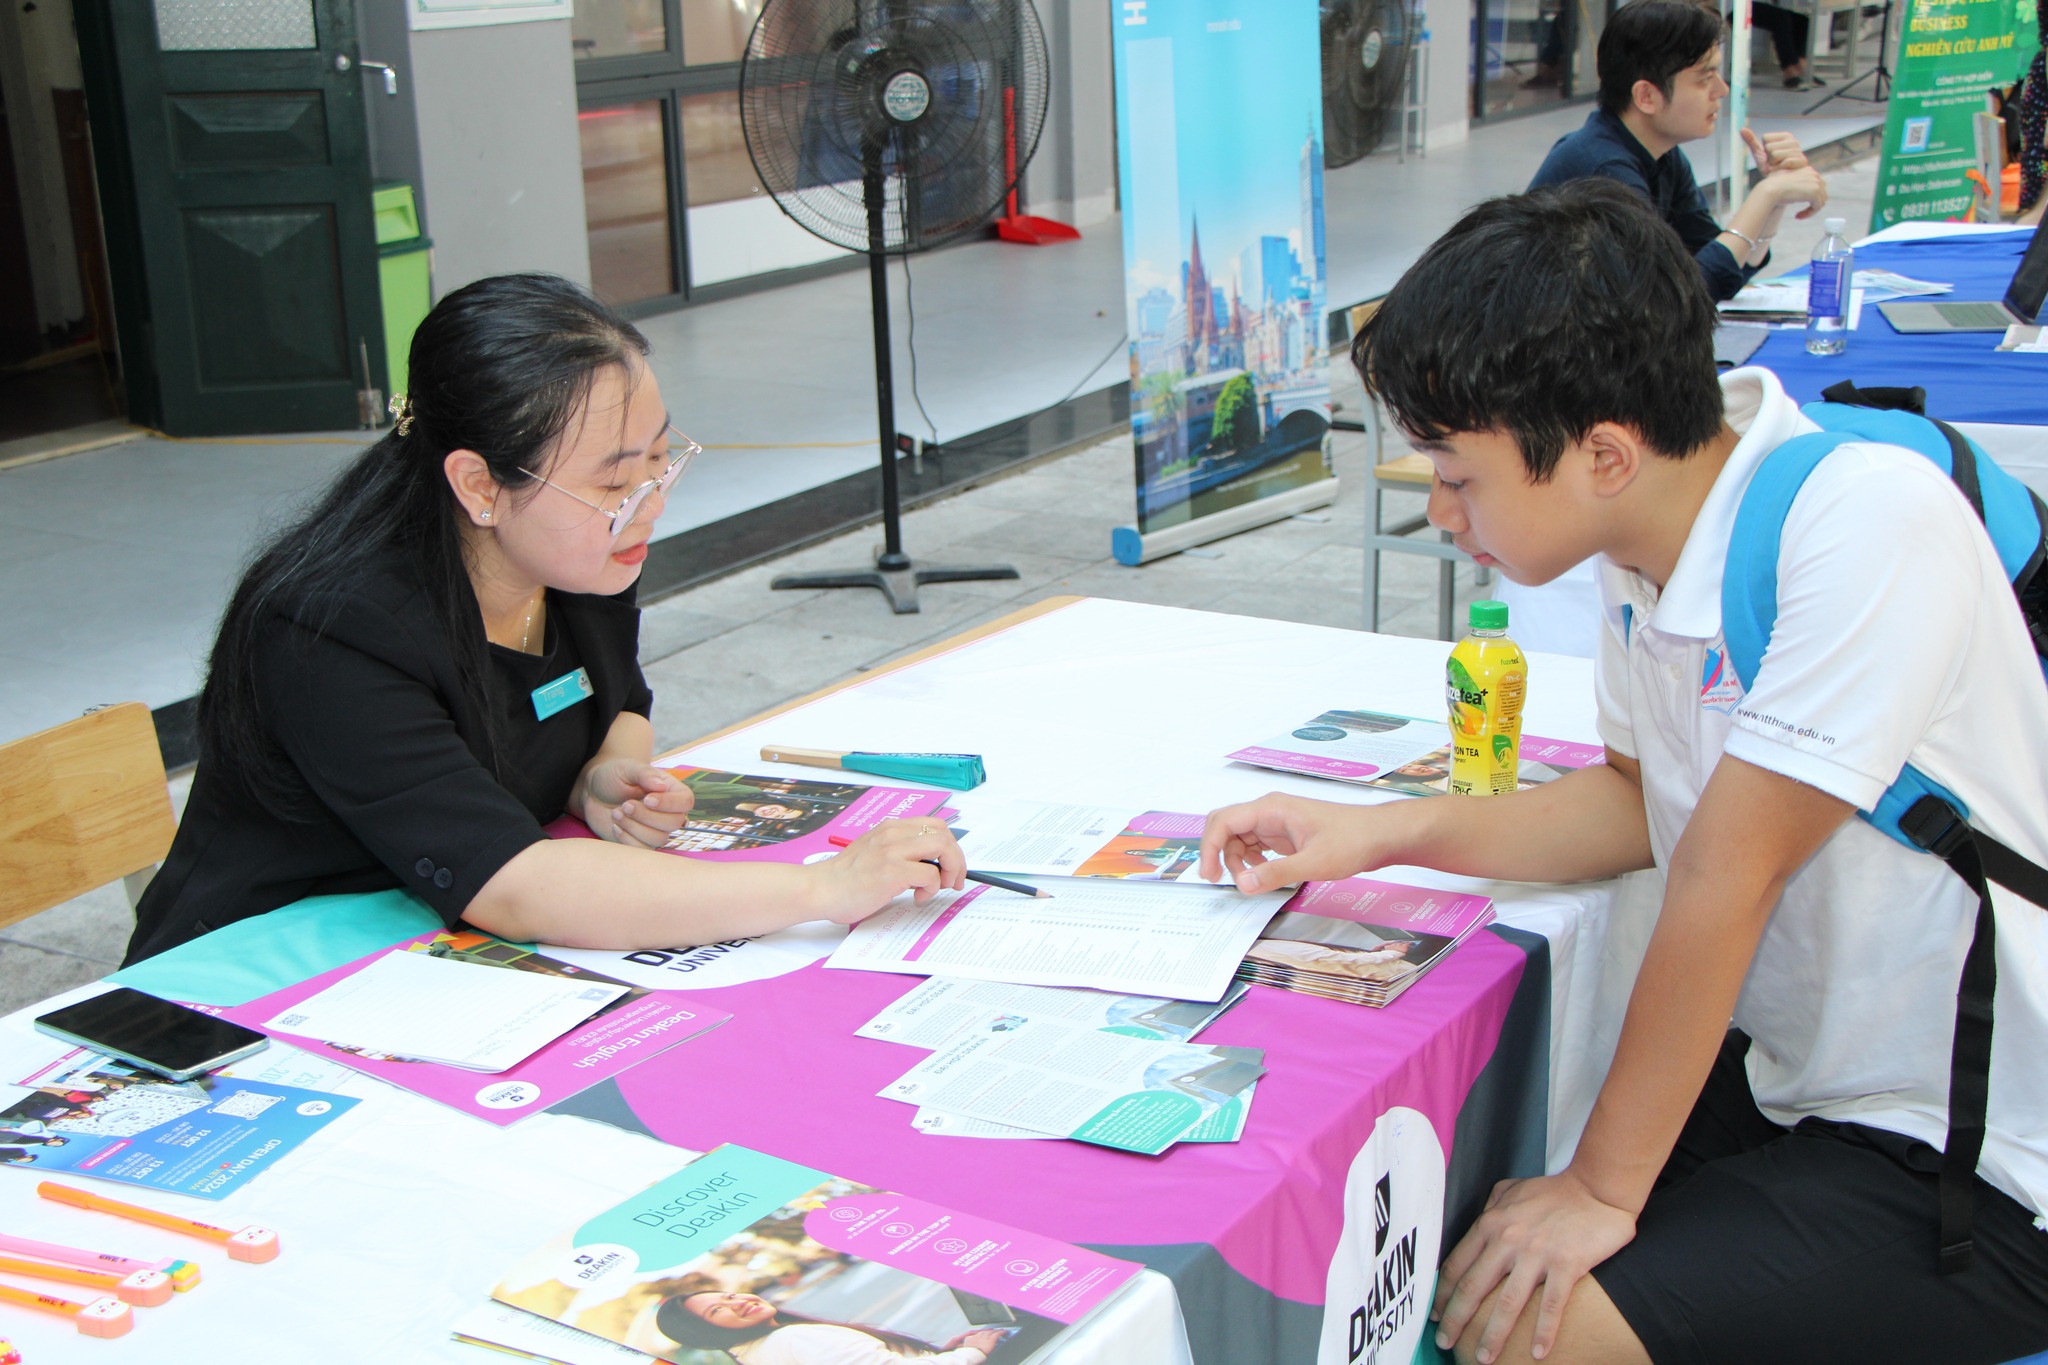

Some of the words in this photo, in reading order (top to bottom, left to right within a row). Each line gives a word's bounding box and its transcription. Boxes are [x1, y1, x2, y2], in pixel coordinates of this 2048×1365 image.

[1910, 15, 1968, 32] BUSINESS
[1977, 36, 1999, 52] ANH
[1901, 201, 1930, 219] 0931
[541, 685, 564, 703] Trang
[1465, 747, 1479, 758] TEA
[888, 793, 925, 816] Deakin
[930, 983, 954, 998] DEAKIN
[634, 1010, 696, 1039] Deakin
[567, 1031, 599, 1046] (DUELI)
[961, 1038, 989, 1055] DEAKIN
[573, 1037, 642, 1068] English
[490, 1086, 524, 1102] DEAKIN
[180, 1136, 201, 1148] OCT
[196, 1129, 211, 1137] 12
[248, 1139, 282, 1160] OPEN
[132, 1167, 153, 1179] OCT
[148, 1160, 164, 1168] 13
[228, 1159, 255, 1175] DAY
[200, 1174, 233, 1193] 2024
[633, 1171, 738, 1228] Discover
[666, 1192, 758, 1239] Deakin
[863, 1213, 876, 1221] TOP
[888, 1240, 913, 1255] RANKED
[926, 1222, 940, 1230] TOP
[969, 1240, 993, 1254] COURSE
[960, 1243, 999, 1267] SATISFACTION
[577, 1252, 620, 1281] DEAKIN
[1036, 1258, 1068, 1279] EDUCATION
[1034, 1266, 1068, 1288] EXPERIENCE
[1349, 1226, 1417, 1365] DEAKIN
